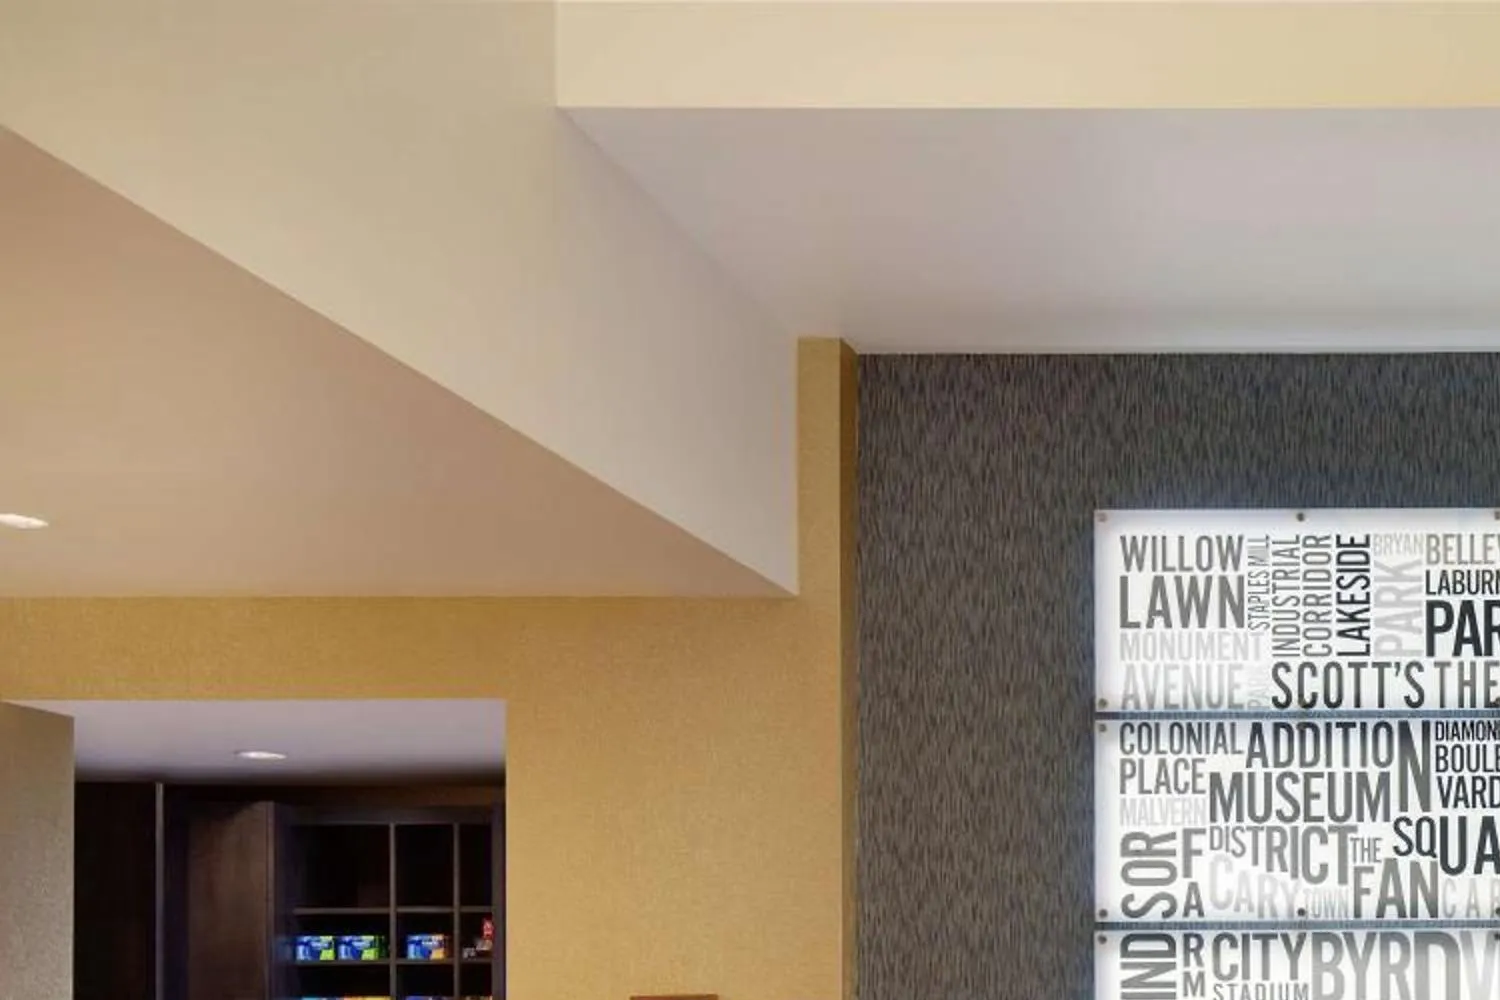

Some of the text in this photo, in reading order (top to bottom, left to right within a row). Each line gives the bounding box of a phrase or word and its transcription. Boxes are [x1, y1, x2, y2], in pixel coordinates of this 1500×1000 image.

[1119, 535, 1244, 572] WILLOW
[1373, 535, 1424, 554] BRYAN
[1119, 575, 1245, 628] LAWN
[1247, 568, 1270, 630] STAPLES
[1272, 535, 1299, 657] INDUSTRIAL
[1302, 535, 1332, 657] CORRIDOR
[1336, 535, 1370, 656] LAKESIDE
[1374, 560, 1423, 656] PARK
[1120, 632, 1264, 661] MONUMENT
[1120, 665, 1245, 709] AVENUE
[1272, 661, 1424, 709] SCOTT'S
[1434, 661, 1500, 709] THE
[1120, 722, 1243, 754] COLONIAL
[1120, 758, 1205, 794] PLACE
[1210, 772, 1390, 823] MUSEUM
[1120, 798, 1205, 825] MALVERN
[1210, 826, 1357, 885] DISTRICT
[1350, 838, 1381, 862] THE
[1210, 856, 1300, 918] CARY
[1354, 858, 1438, 918] FAN
[1213, 933, 1306, 980] CITY
